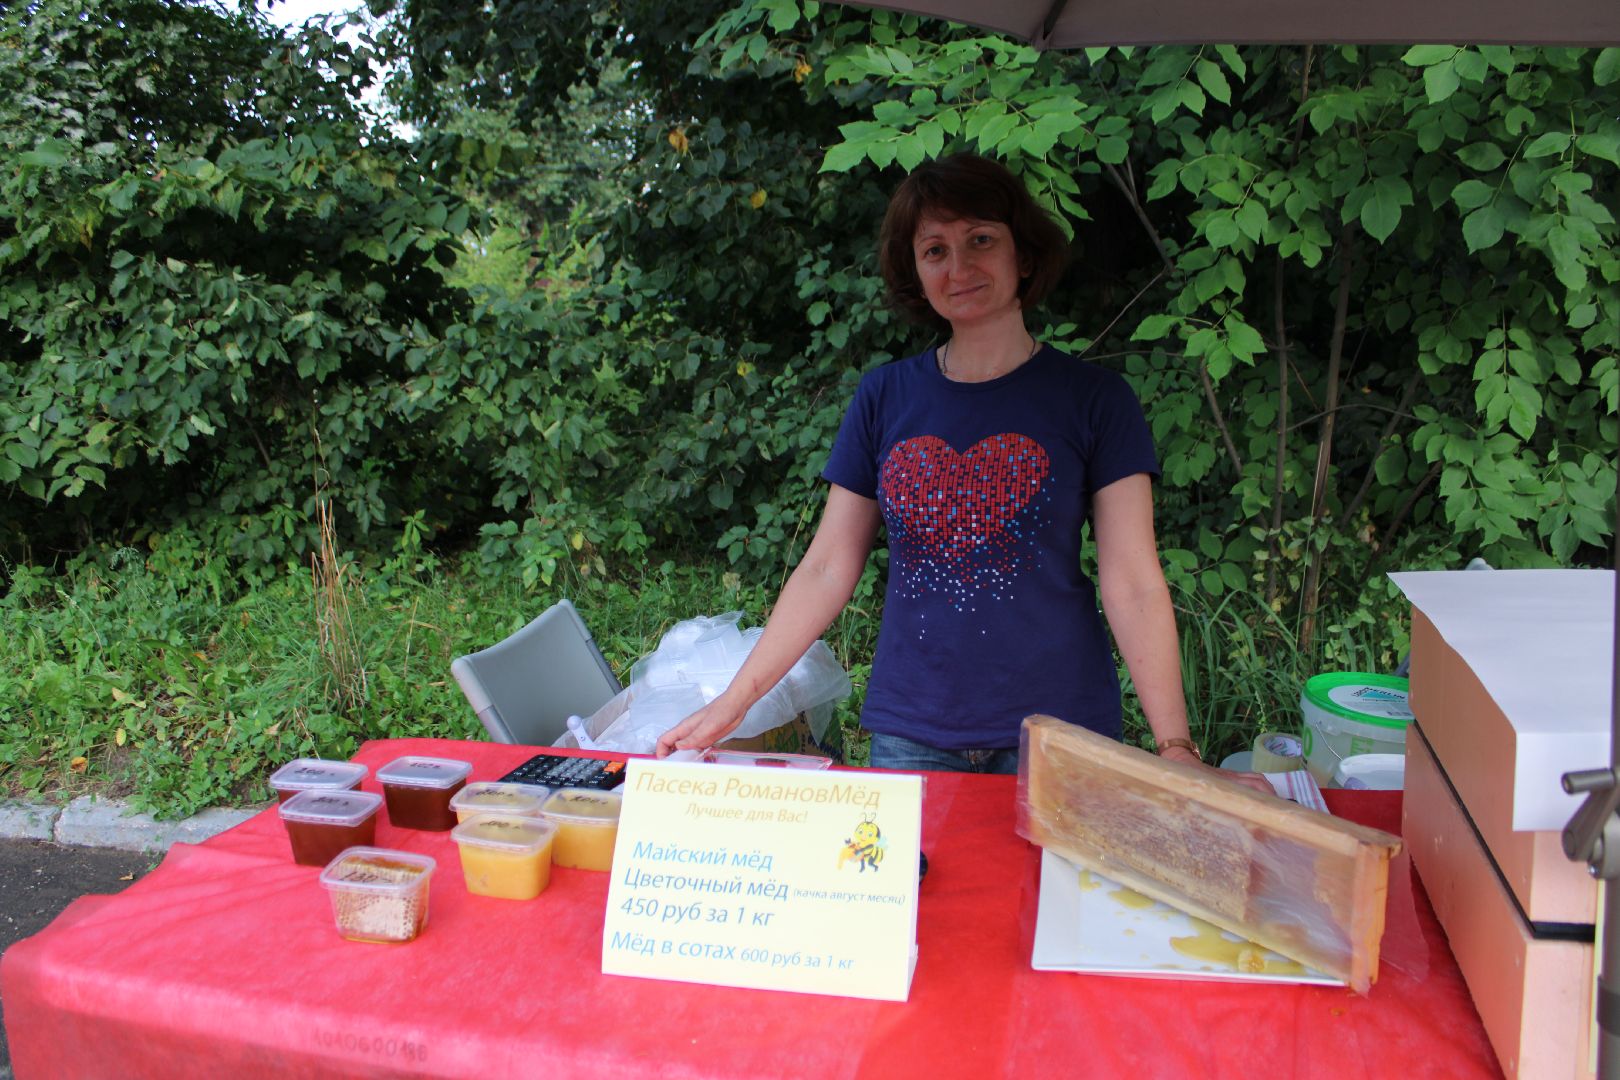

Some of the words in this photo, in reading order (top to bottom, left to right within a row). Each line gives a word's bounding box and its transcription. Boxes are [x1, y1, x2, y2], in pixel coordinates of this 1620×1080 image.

[636, 772, 717, 797] Пасека
[724, 778, 881, 808] РомановМёд
[685, 803, 743, 820] Лучшее
[745, 809, 774, 823] для
[777, 809, 809, 824] Вас!
[633, 841, 728, 865] Майский
[732, 851, 773, 872] мёд
[623, 868, 742, 895] Цветочный
[747, 879, 789, 901] мёд
[829, 890, 865, 903] август
[621, 898, 659, 917] 450
[662, 901, 702, 924] руб
[706, 909, 728, 923] за
[737, 907, 745, 923] 1
[752, 912, 776, 927] кг
[611, 931, 656, 955] Мёд
[661, 940, 673, 953] в
[679, 941, 735, 960] сотах
[741, 948, 768, 963] 600
[772, 951, 801, 968] руб
[804, 955, 821, 968] за
[827, 955, 833, 968] 1
[838, 958, 855, 970] кг
